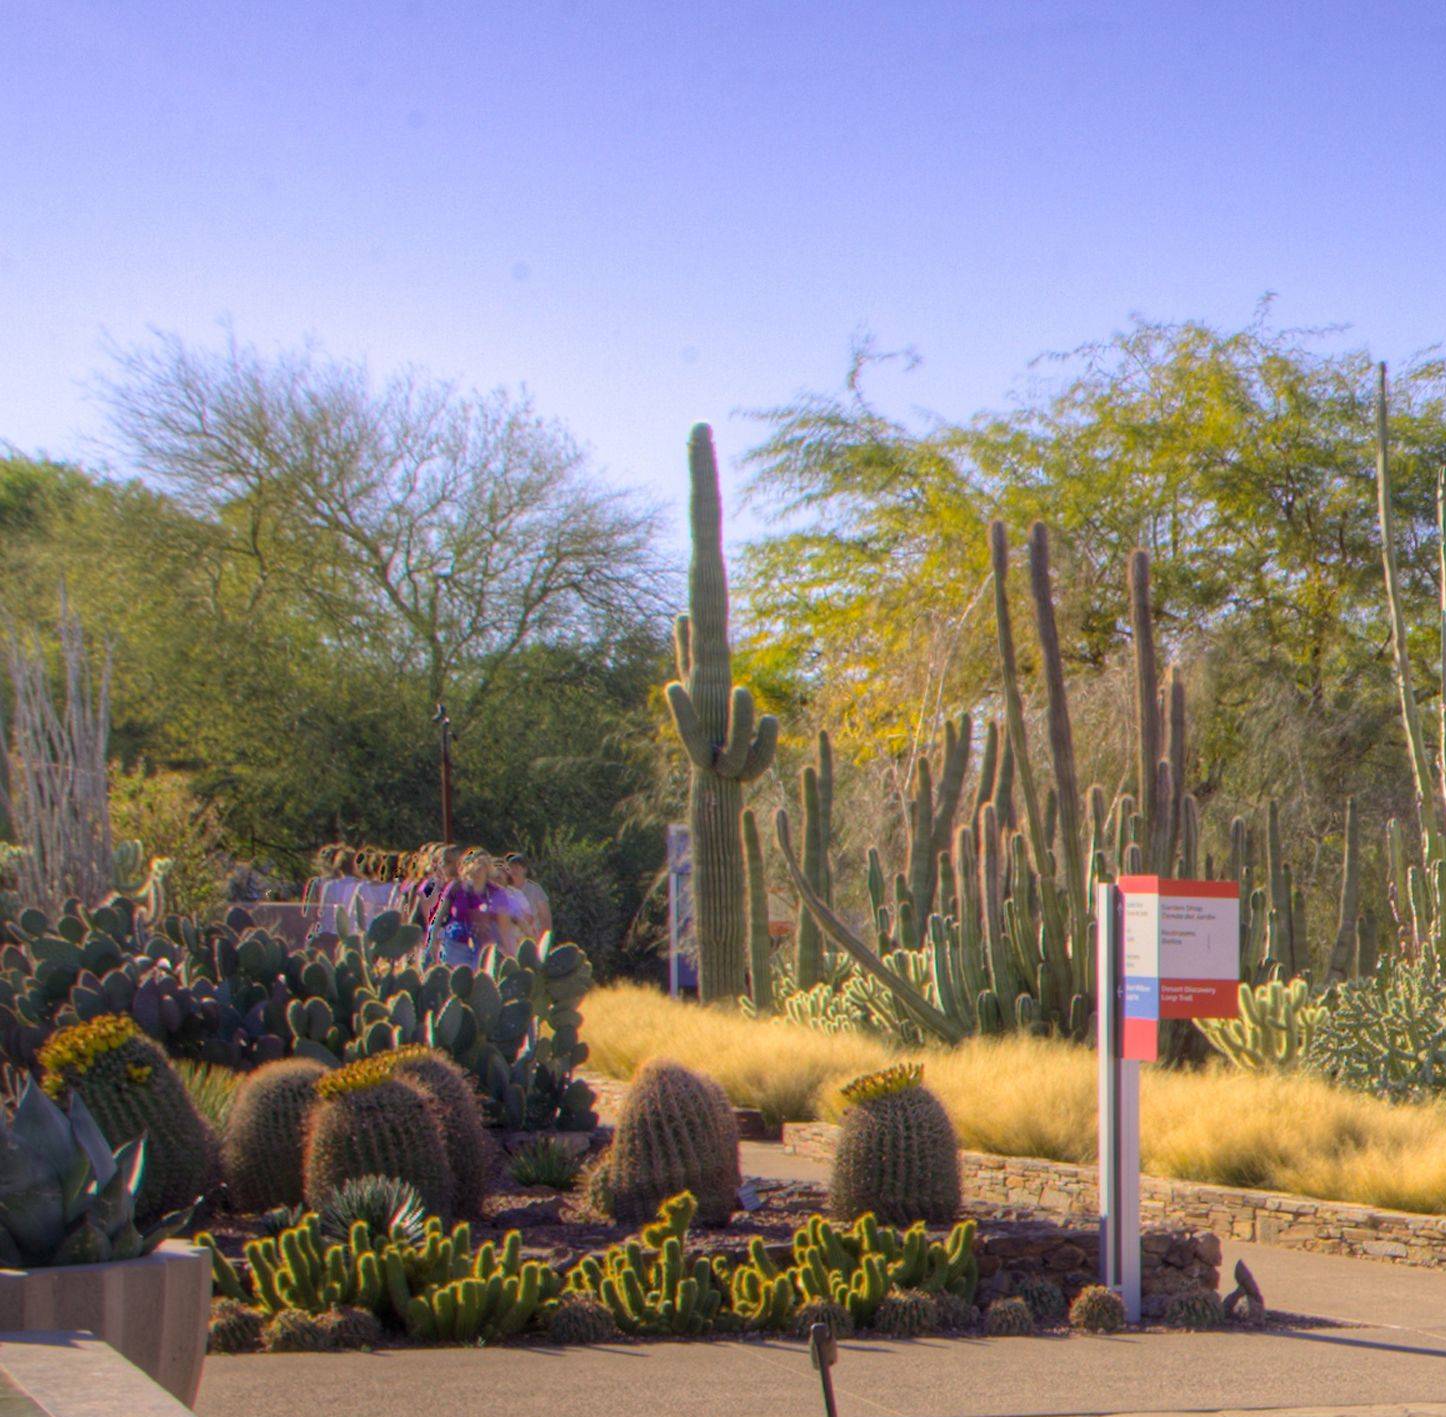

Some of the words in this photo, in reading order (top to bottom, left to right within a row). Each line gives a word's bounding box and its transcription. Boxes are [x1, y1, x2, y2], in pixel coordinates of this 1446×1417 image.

[1161, 985, 1183, 993] Desert
[1184, 985, 1217, 996] Discovery
[1161, 994, 1178, 1002] Loop
[1179, 994, 1193, 1002] Trail
